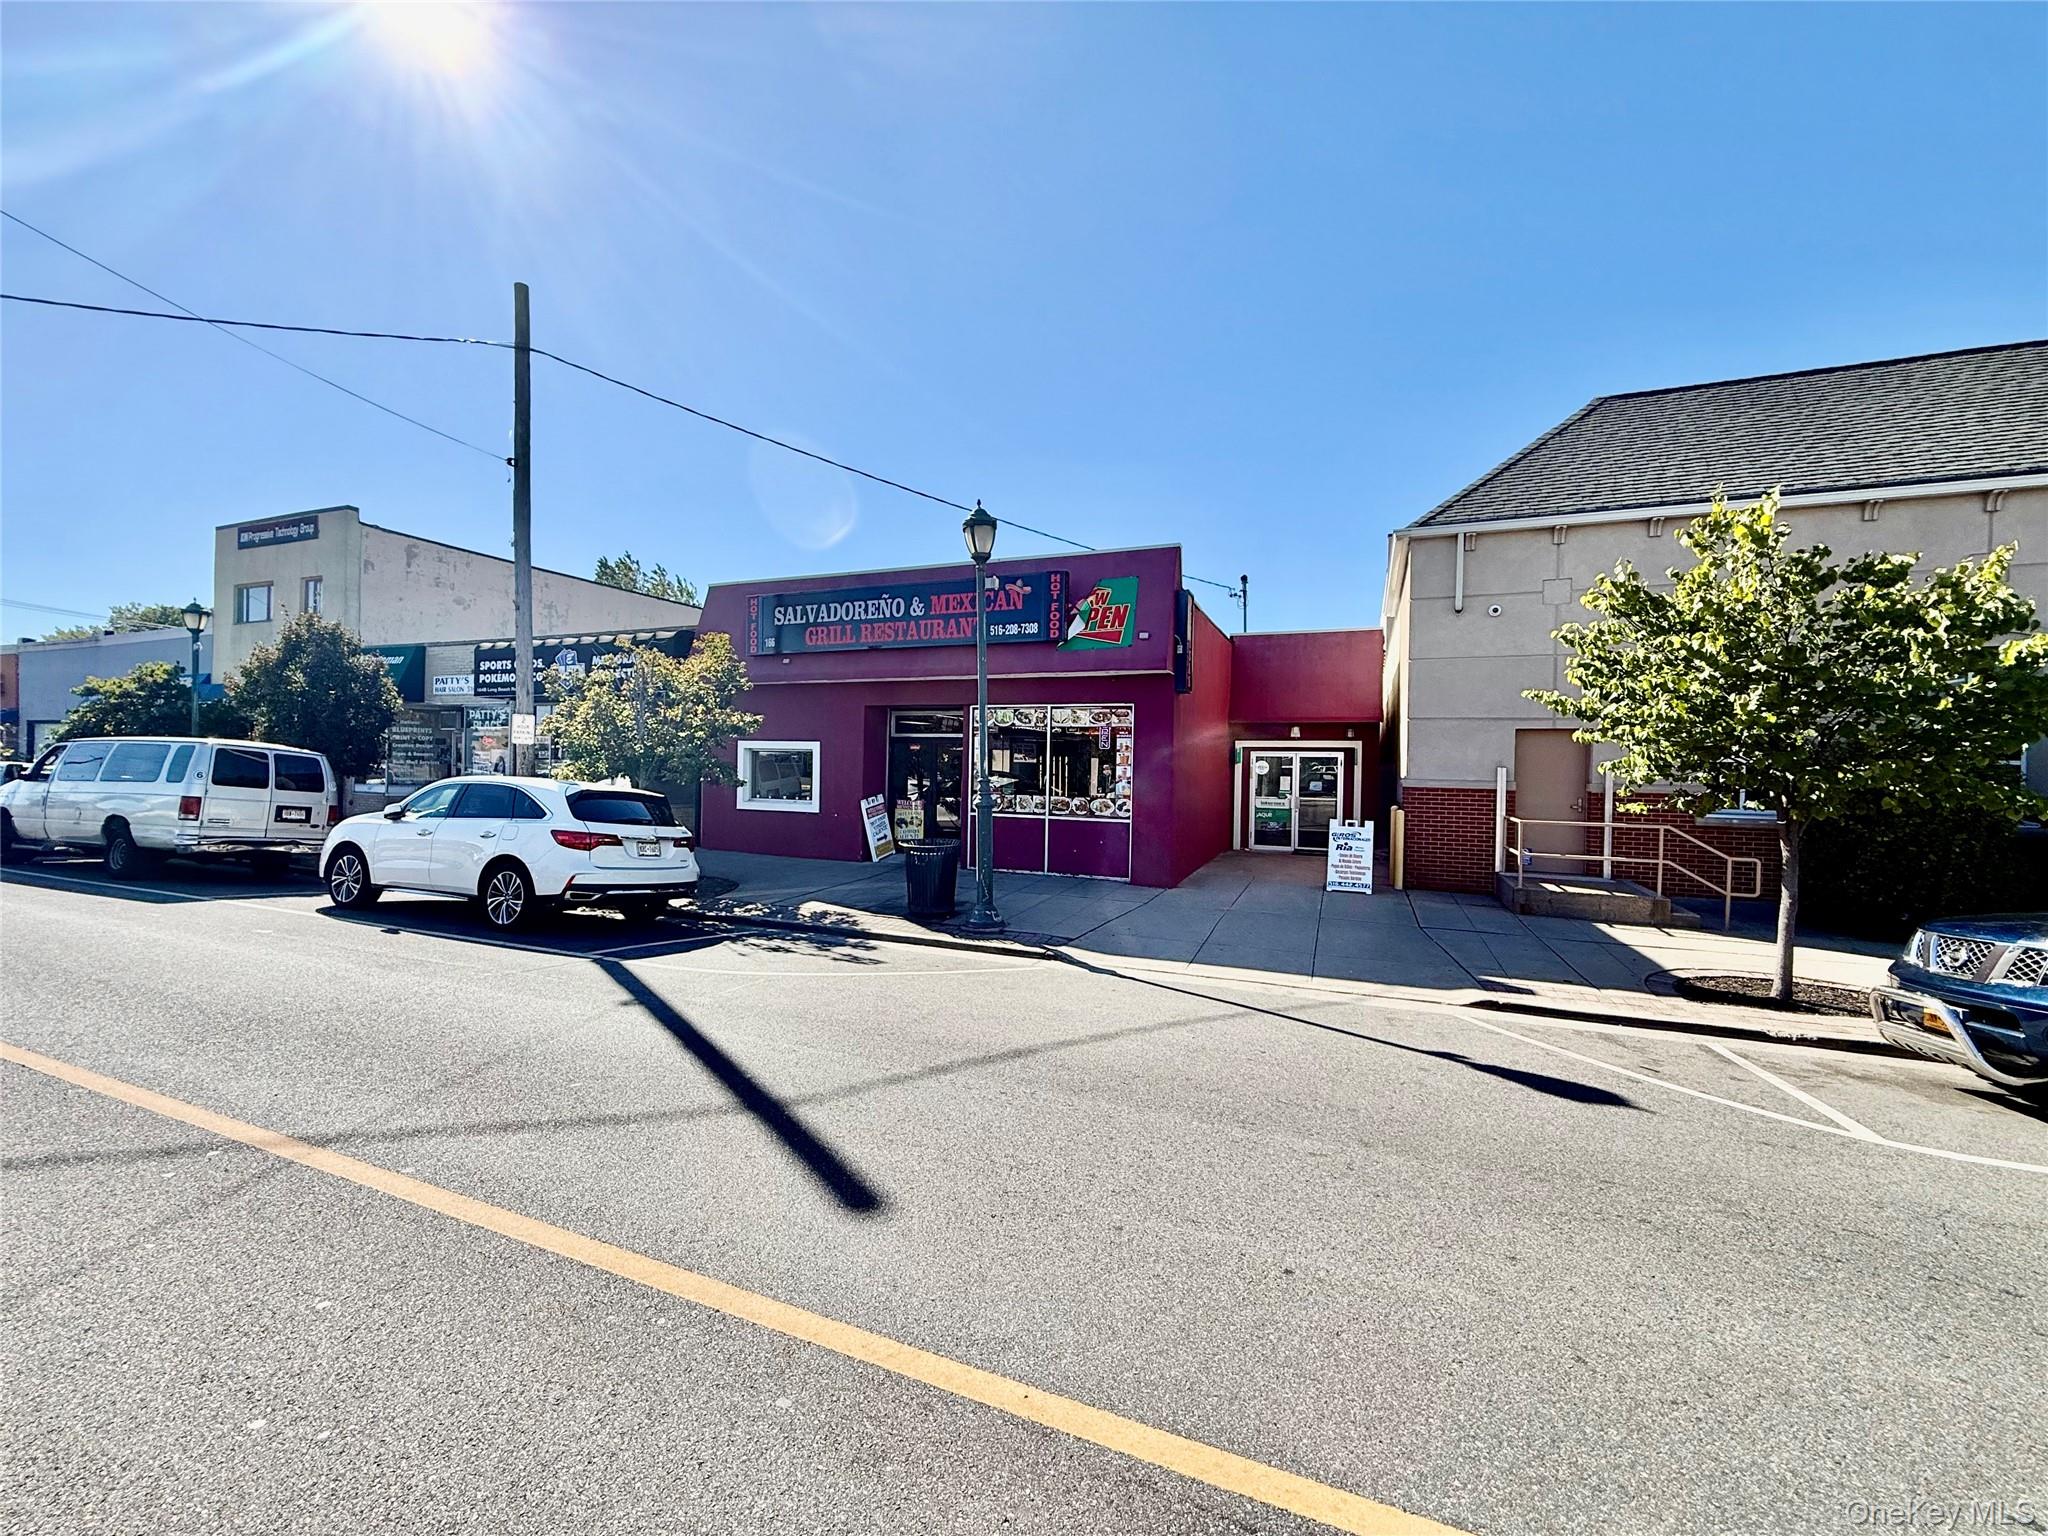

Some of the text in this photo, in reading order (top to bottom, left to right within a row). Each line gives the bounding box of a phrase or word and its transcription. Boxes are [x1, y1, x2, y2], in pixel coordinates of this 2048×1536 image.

[300, 523, 315, 535] Group
[774, 590, 1023, 626] SALVADOREÑO & MEXCAN
[1049, 574, 1060, 638] HOT FOOD
[1084, 604, 1130, 631] PEN
[989, 622, 1039, 636] 516-208-7308
[805, 625, 856, 646] GRILL
[479, 660, 512, 671] SPORTS
[434, 676, 470, 685] PATTY'S
[479, 671, 517, 683] POKÉMO
[196, 771, 204, 779] 6
[1336, 842, 1353, 851] Ria
